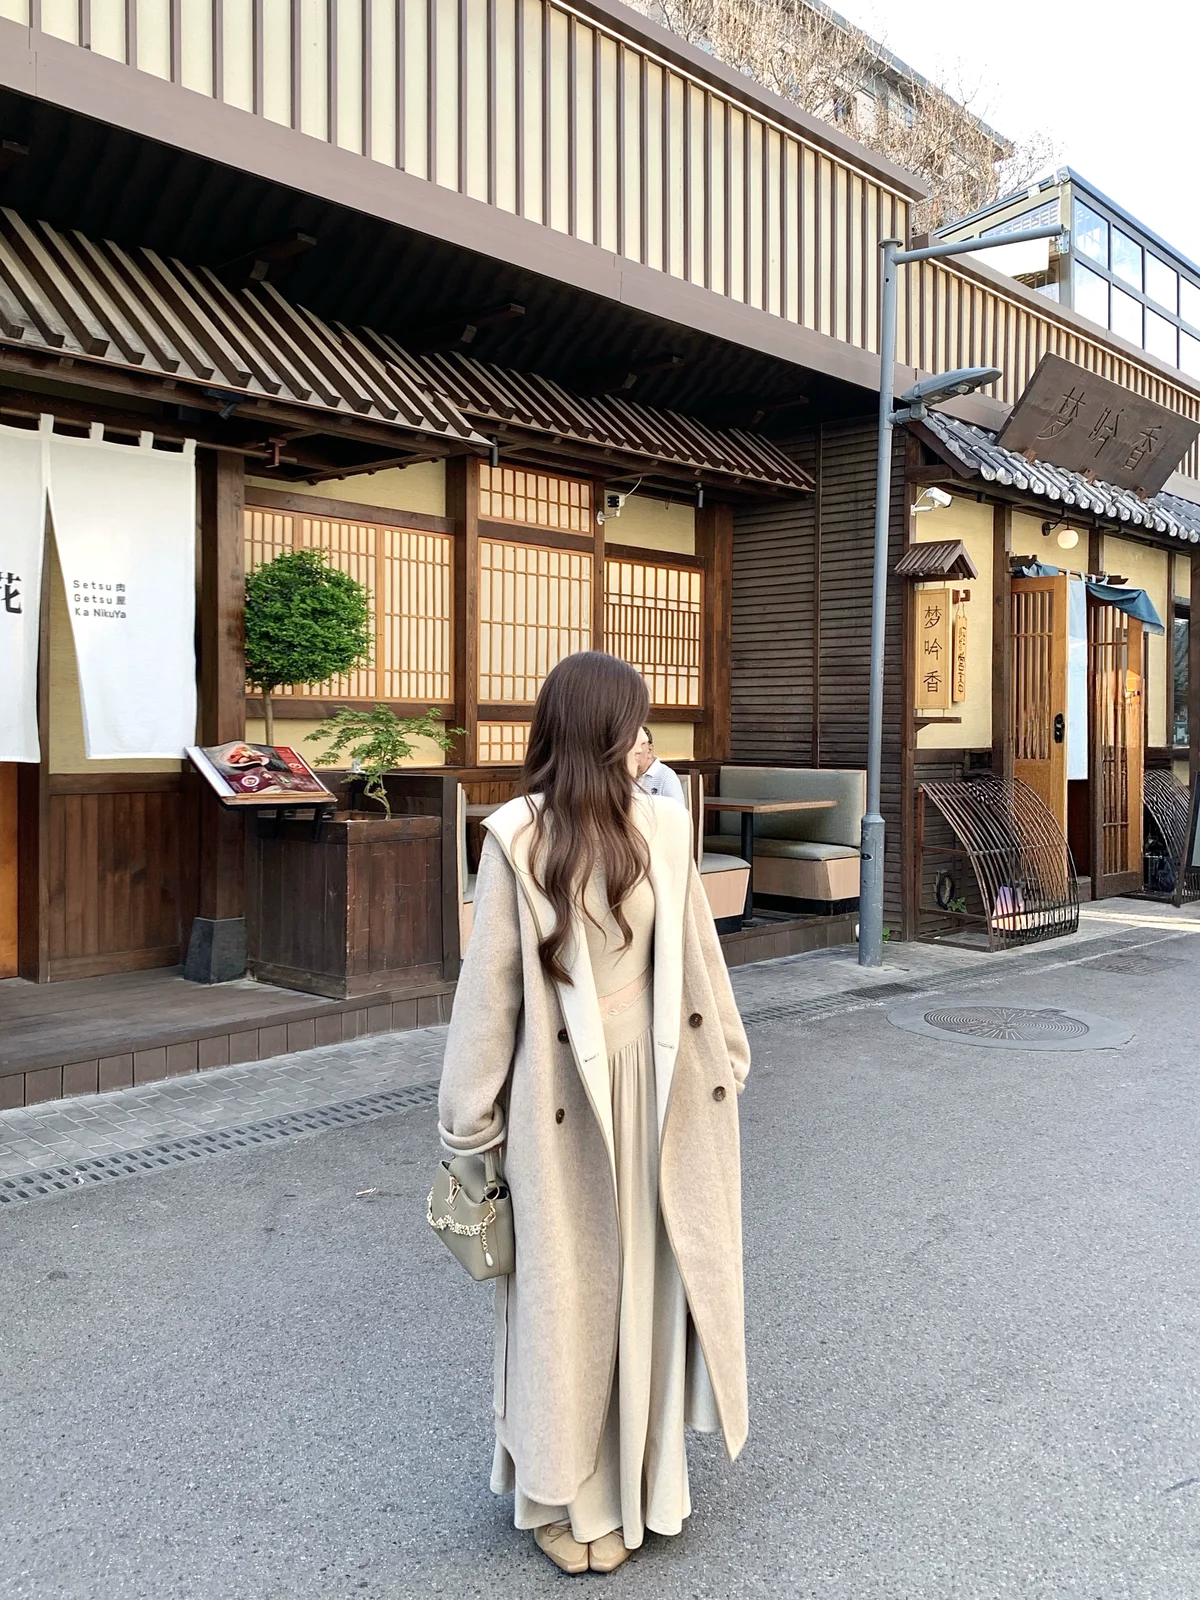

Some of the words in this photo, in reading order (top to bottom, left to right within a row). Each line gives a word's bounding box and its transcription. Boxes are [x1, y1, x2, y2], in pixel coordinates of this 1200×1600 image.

[73, 580, 112, 591] Setsu
[74, 594, 112, 605] Getsu
[75, 608, 89, 616] Ka
[93, 608, 126, 618] NikuYa
[923, 605, 942, 693] 梦吟香
